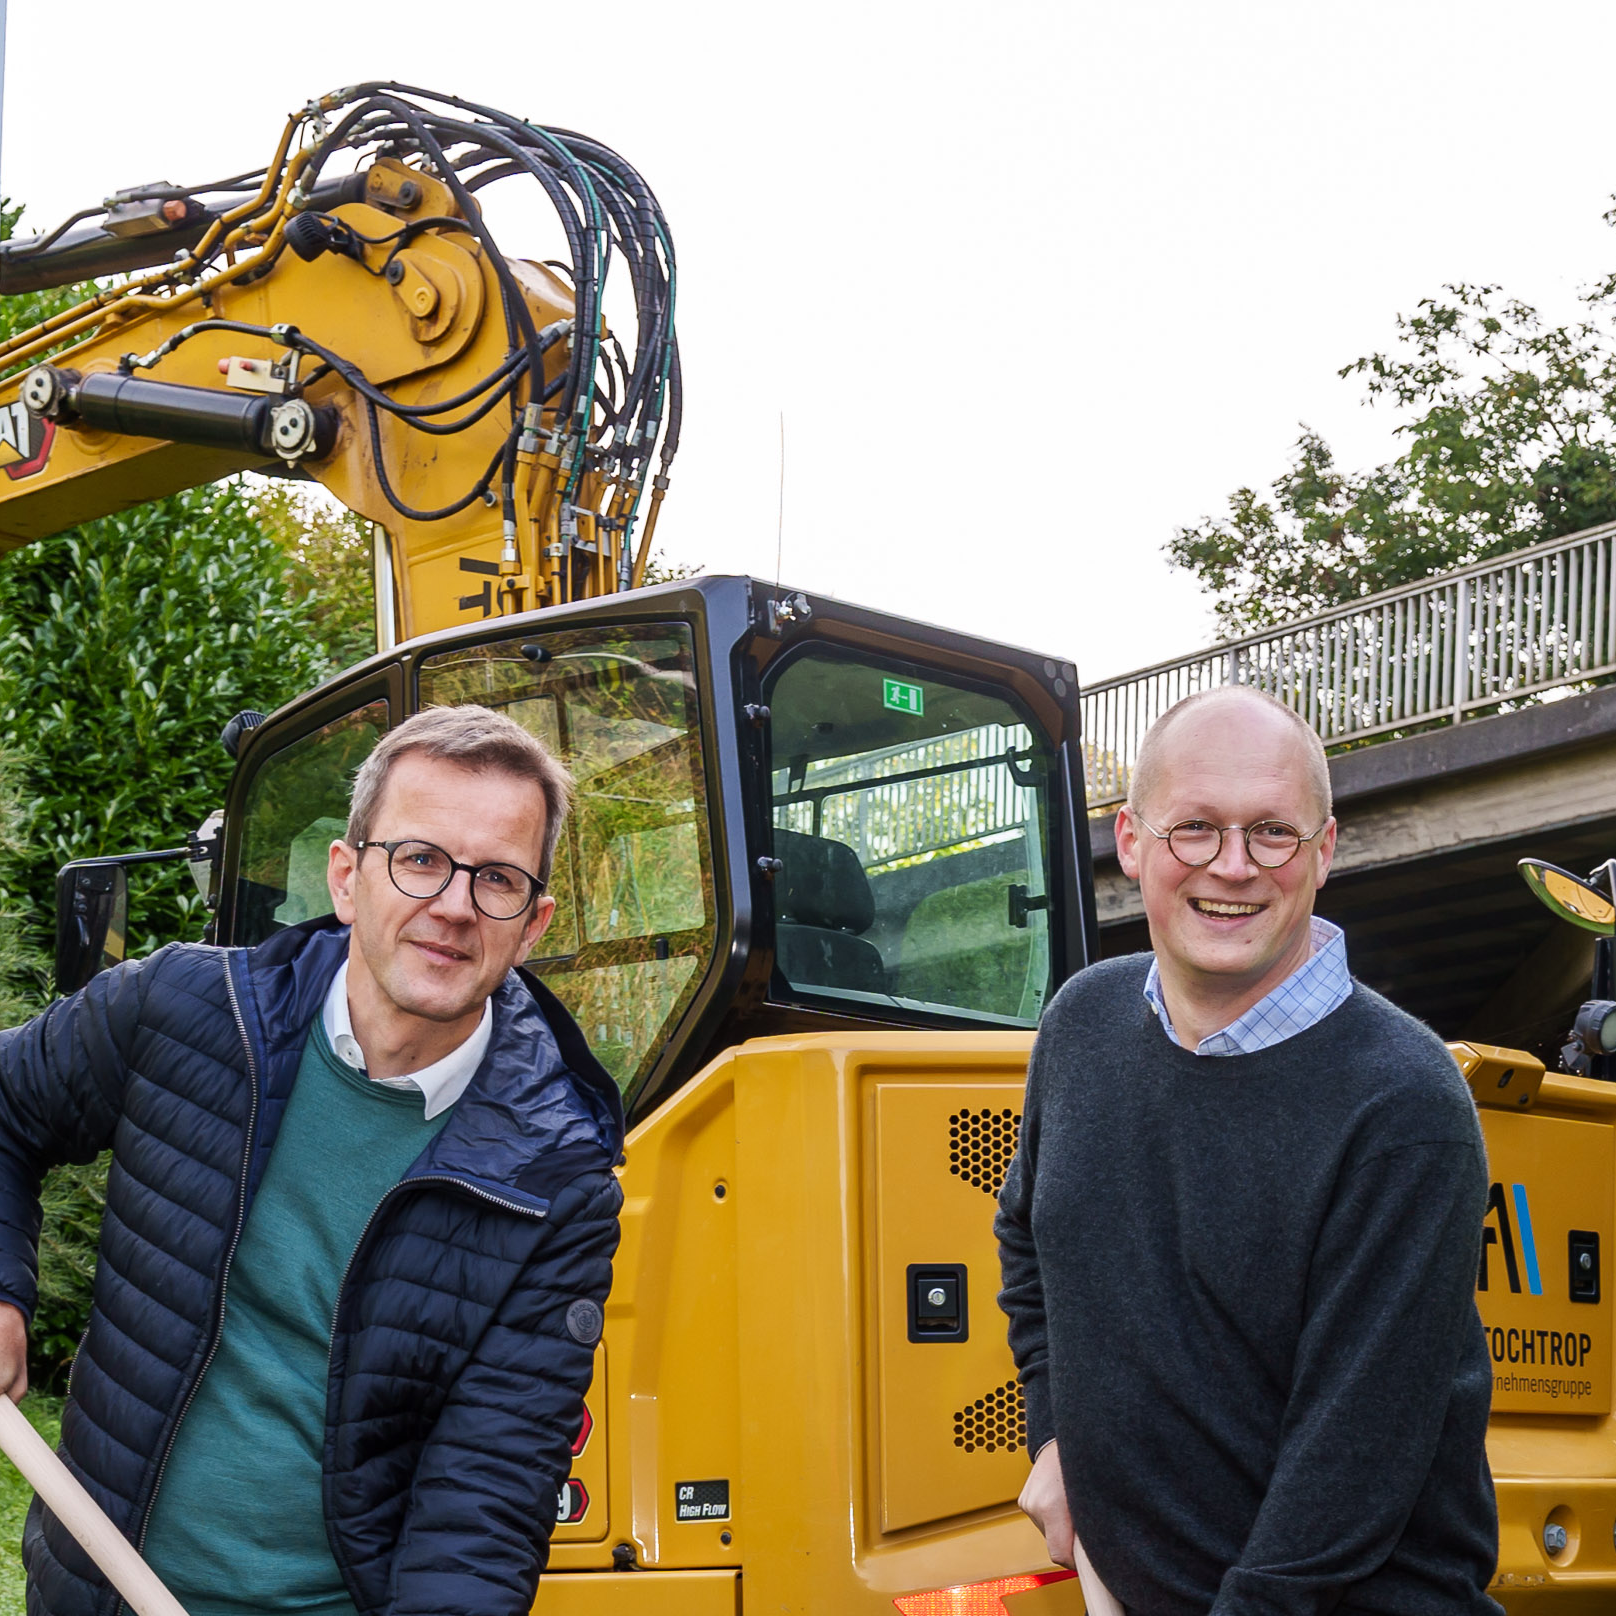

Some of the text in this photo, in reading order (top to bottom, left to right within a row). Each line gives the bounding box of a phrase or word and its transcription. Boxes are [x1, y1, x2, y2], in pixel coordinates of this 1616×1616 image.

[1484, 1326, 1592, 1368] OCHTROP
[1492, 1372, 1592, 1400] nehmensgruppe
[678, 1486, 695, 1501] CR
